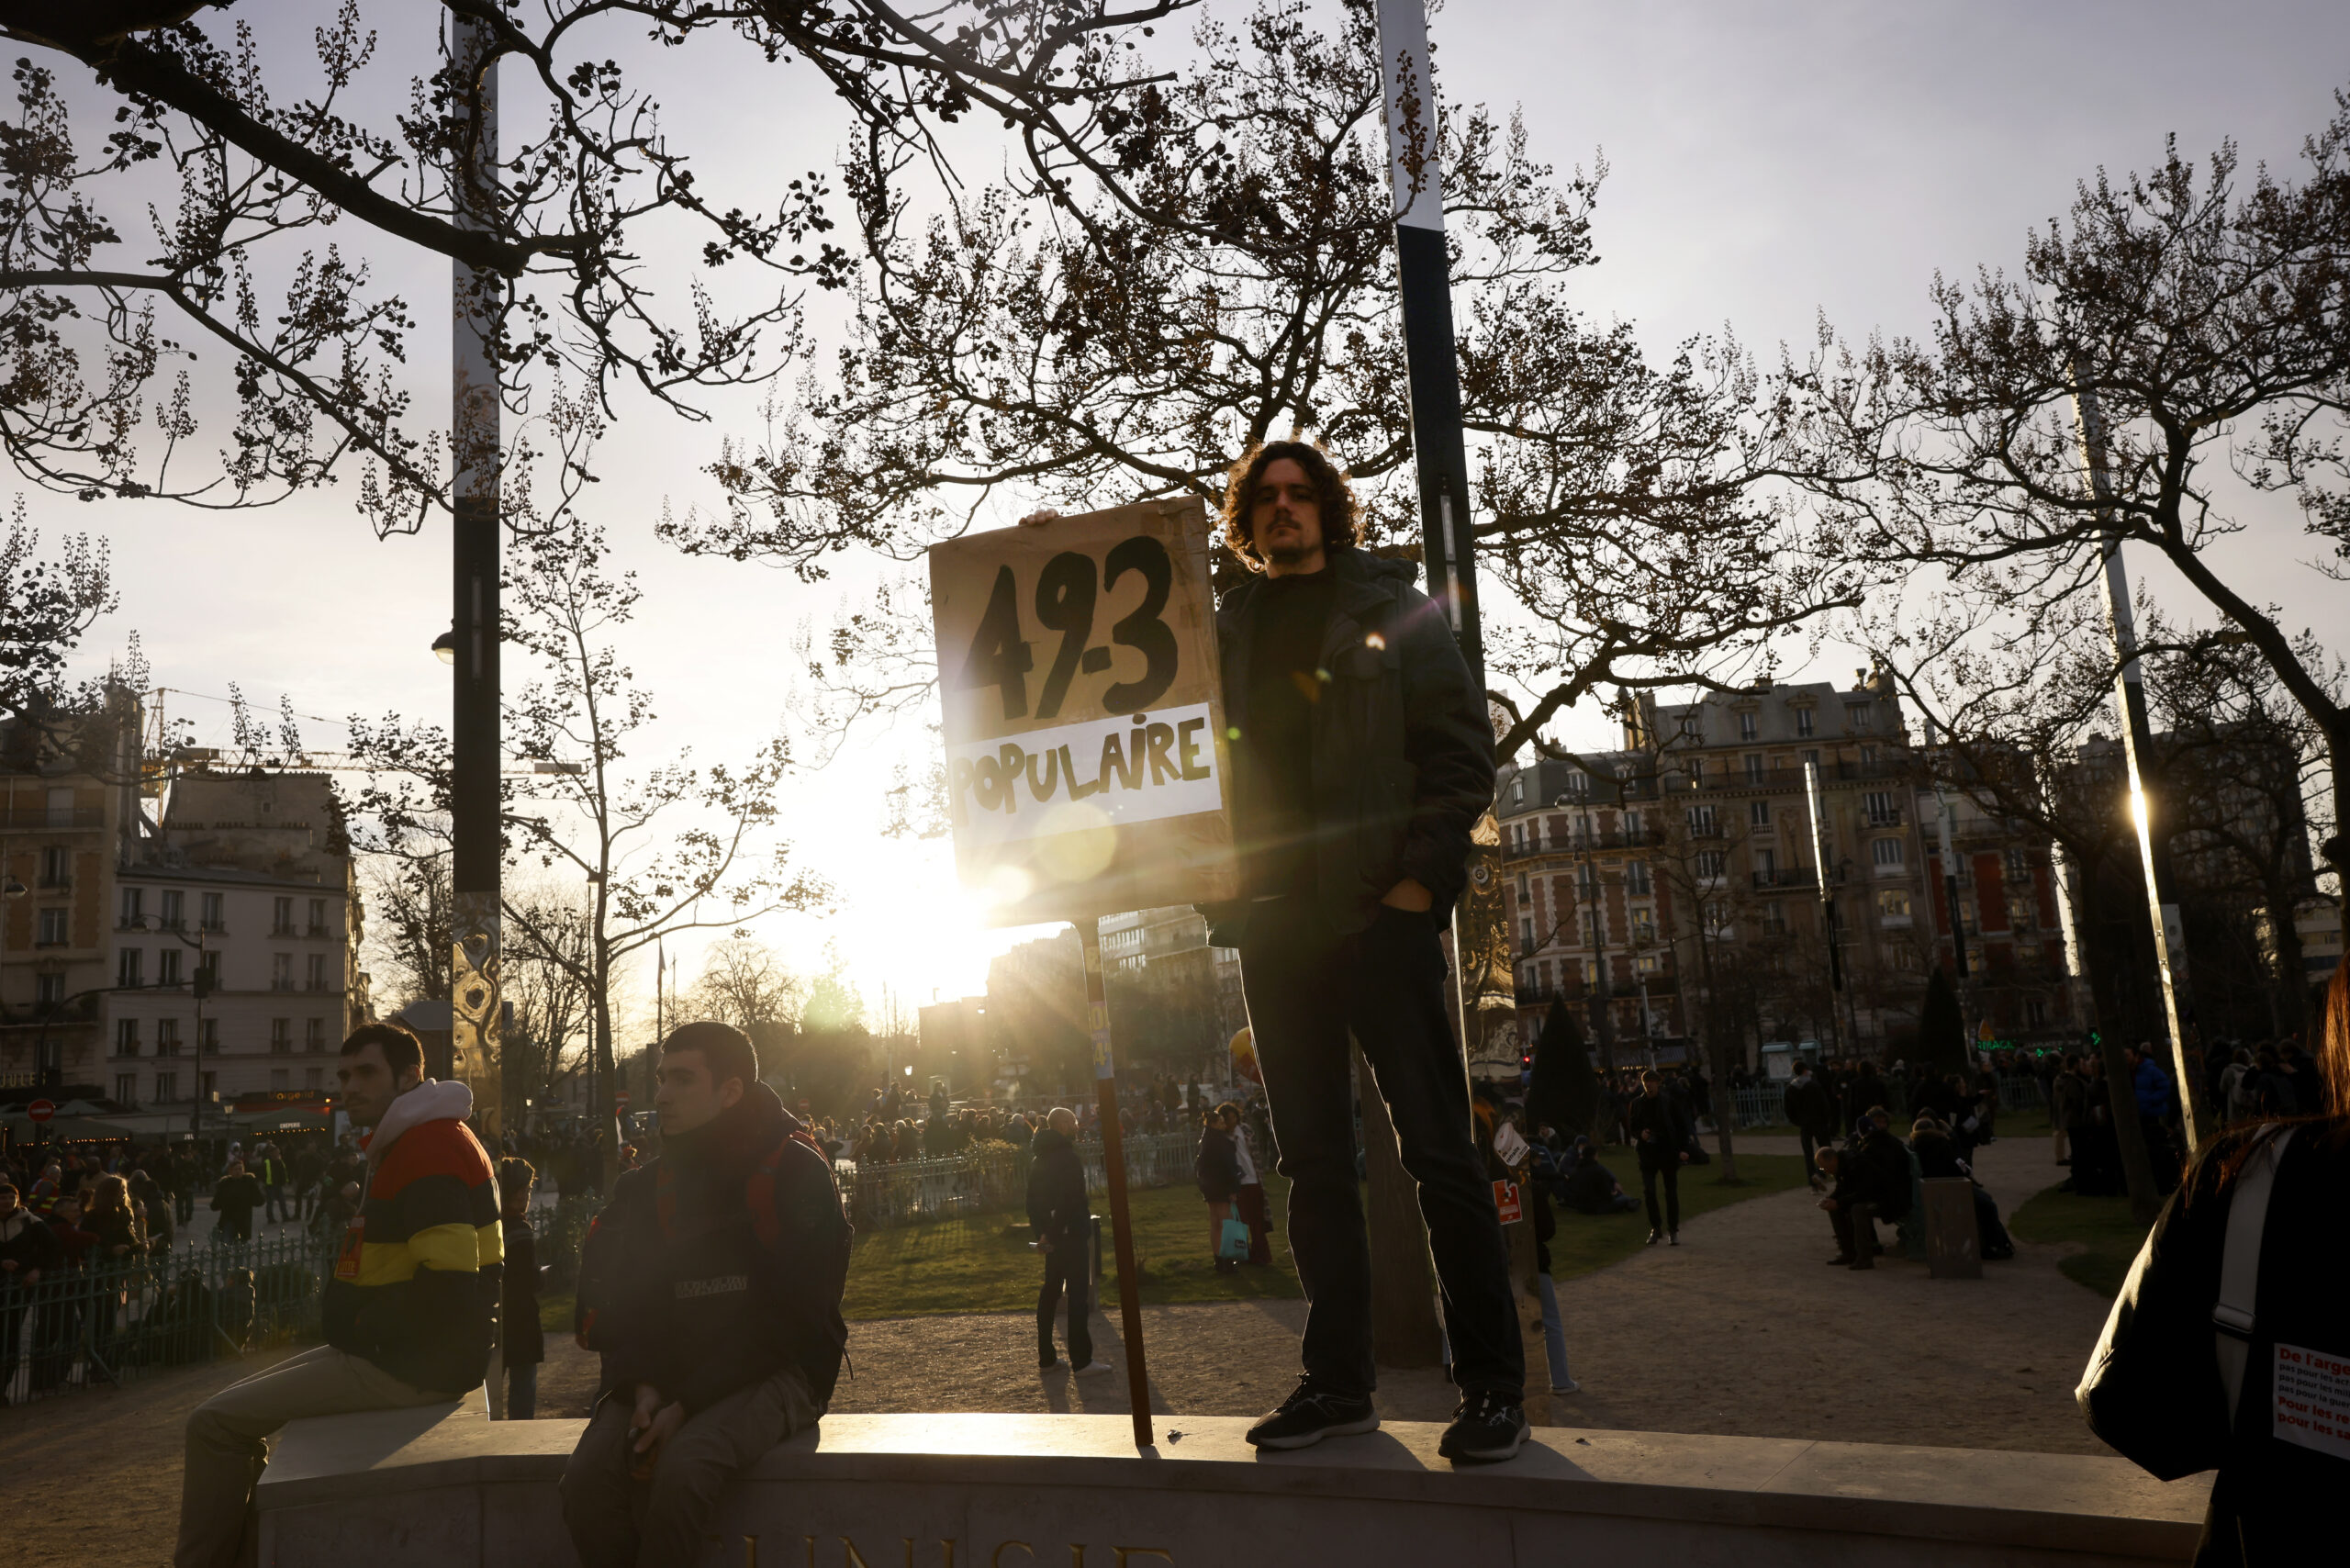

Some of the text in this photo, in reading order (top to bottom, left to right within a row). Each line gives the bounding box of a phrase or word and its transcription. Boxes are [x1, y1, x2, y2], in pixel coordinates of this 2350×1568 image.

[2280, 1348, 2301, 1362] De
[2279, 1364, 2295, 1372] pas
[2297, 1368, 2318, 1378] pour
[2320, 1372, 2333, 1383] les
[2297, 1379, 2318, 1388] pour
[2320, 1383, 2333, 1393] les
[2278, 1384, 2294, 1393] pas
[2296, 1389, 2317, 1399] pour
[2319, 1394, 2327, 1403] la
[2312, 1405, 2332, 1419] les
[2312, 1420, 2333, 1435] les
